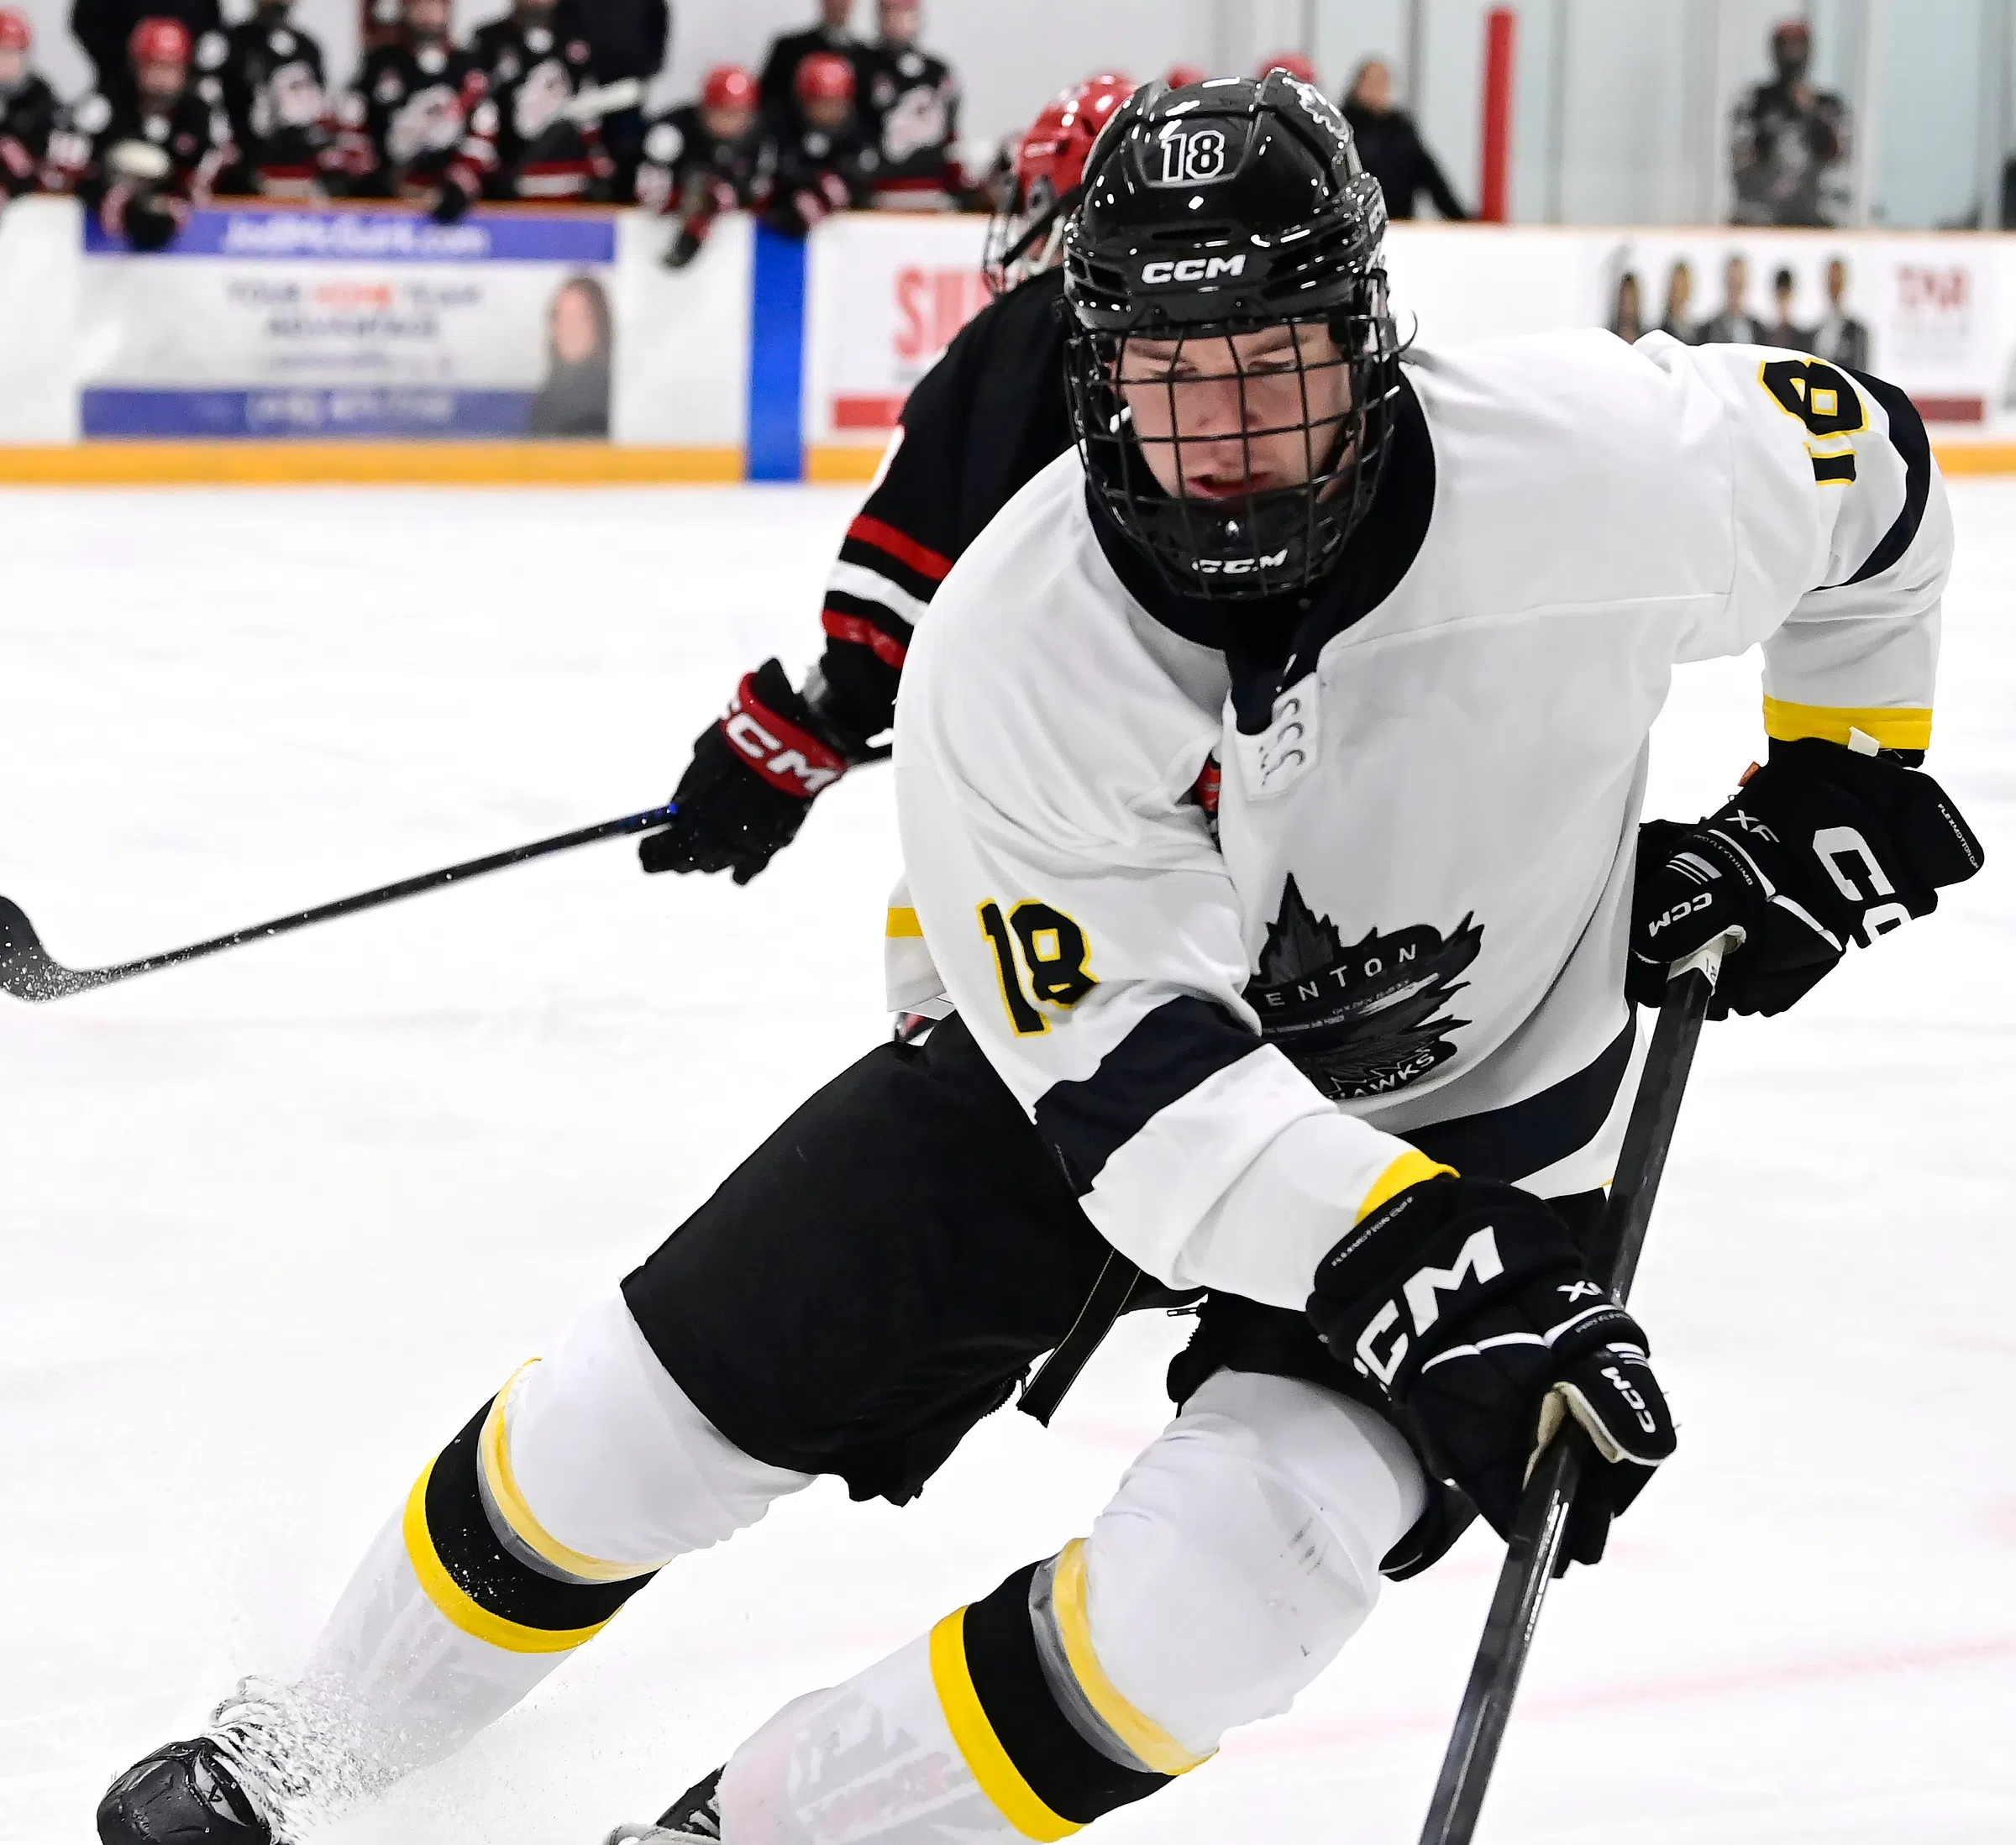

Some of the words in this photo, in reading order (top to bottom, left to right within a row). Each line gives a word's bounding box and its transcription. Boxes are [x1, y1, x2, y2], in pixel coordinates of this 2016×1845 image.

[1161, 130, 1226, 182] 18
[1142, 254, 1247, 284] CCM
[1191, 548, 1289, 574] CCM
[724, 697, 840, 792] CM
[1725, 810, 1781, 843] XF
[1649, 892, 1713, 938] CCM
[976, 897, 1101, 1038] 18
[1600, 1366, 1656, 1434] CCM
